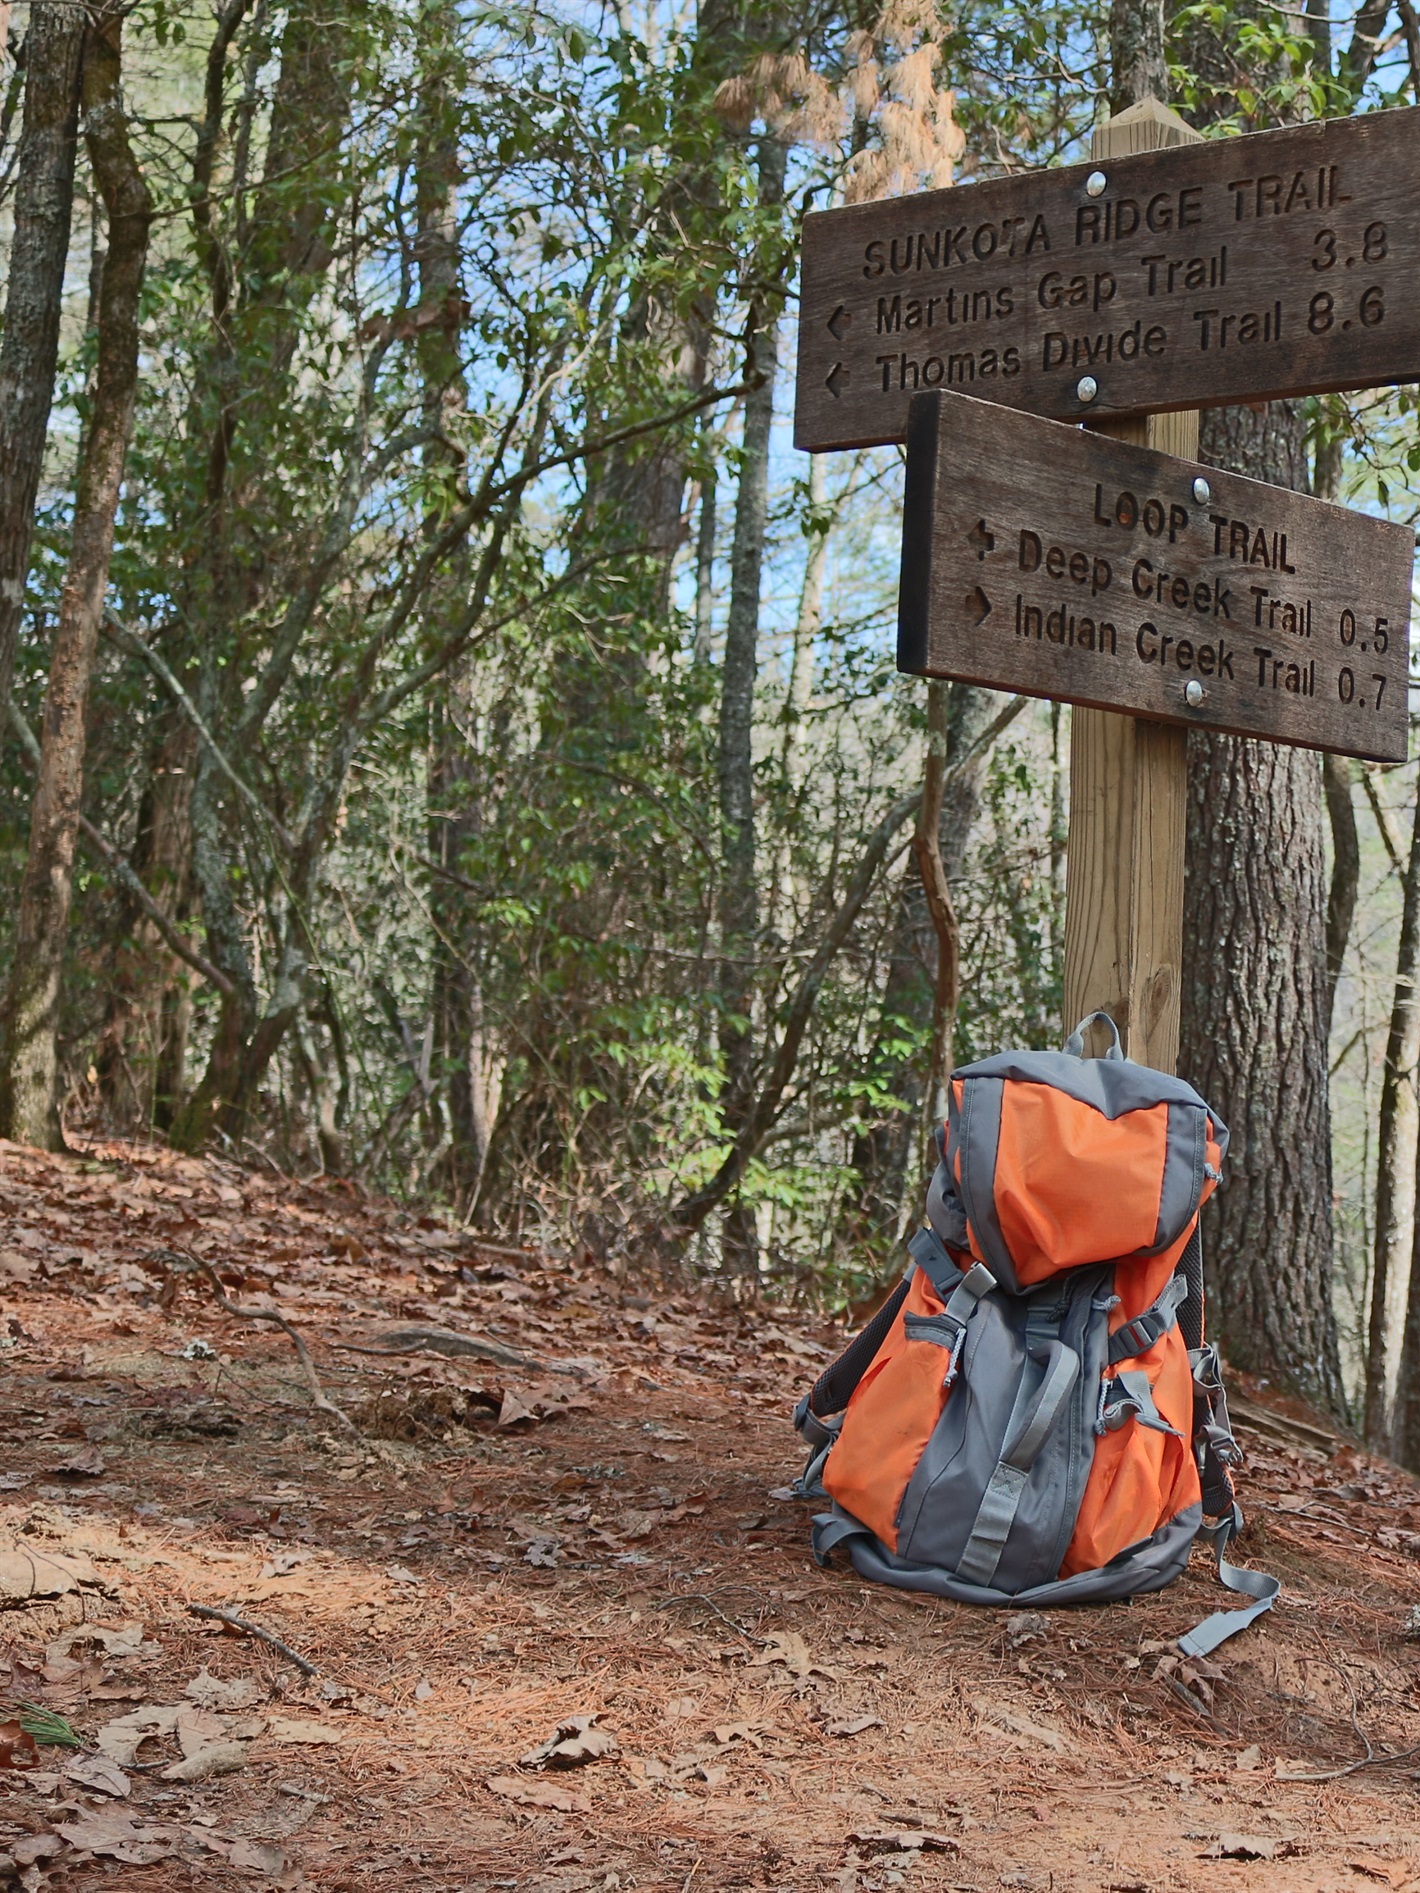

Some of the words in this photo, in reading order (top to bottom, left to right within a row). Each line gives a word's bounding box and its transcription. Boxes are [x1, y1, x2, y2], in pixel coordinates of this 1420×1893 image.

[863, 213, 1050, 279] SUNKOTA
[1075, 187, 1202, 244] RIDGE
[1227, 165, 1352, 222] TRAIL
[875, 282, 1014, 335] Martins
[1037, 269, 1117, 312] Gap
[1141, 246, 1228, 297] Trail
[1311, 221, 1389, 273] 3.8
[875, 345, 1021, 392] Thomas
[1042, 319, 1167, 372] Divide
[1194, 301, 1282, 351] Trail
[1307, 285, 1386, 336] 8.6
[1095, 483, 1189, 543] LOOP
[1209, 514, 1296, 575] TRAIL
[1019, 529, 1112, 596] Deep
[1132, 558, 1232, 619] Creek
[1250, 586, 1311, 638] Trail
[1340, 608, 1389, 655] 0.5
[1015, 594, 1117, 656] Indian
[1136, 622, 1235, 681] Creek
[1253, 647, 1315, 697] Trail
[1338, 667, 1387, 711] 0.7
